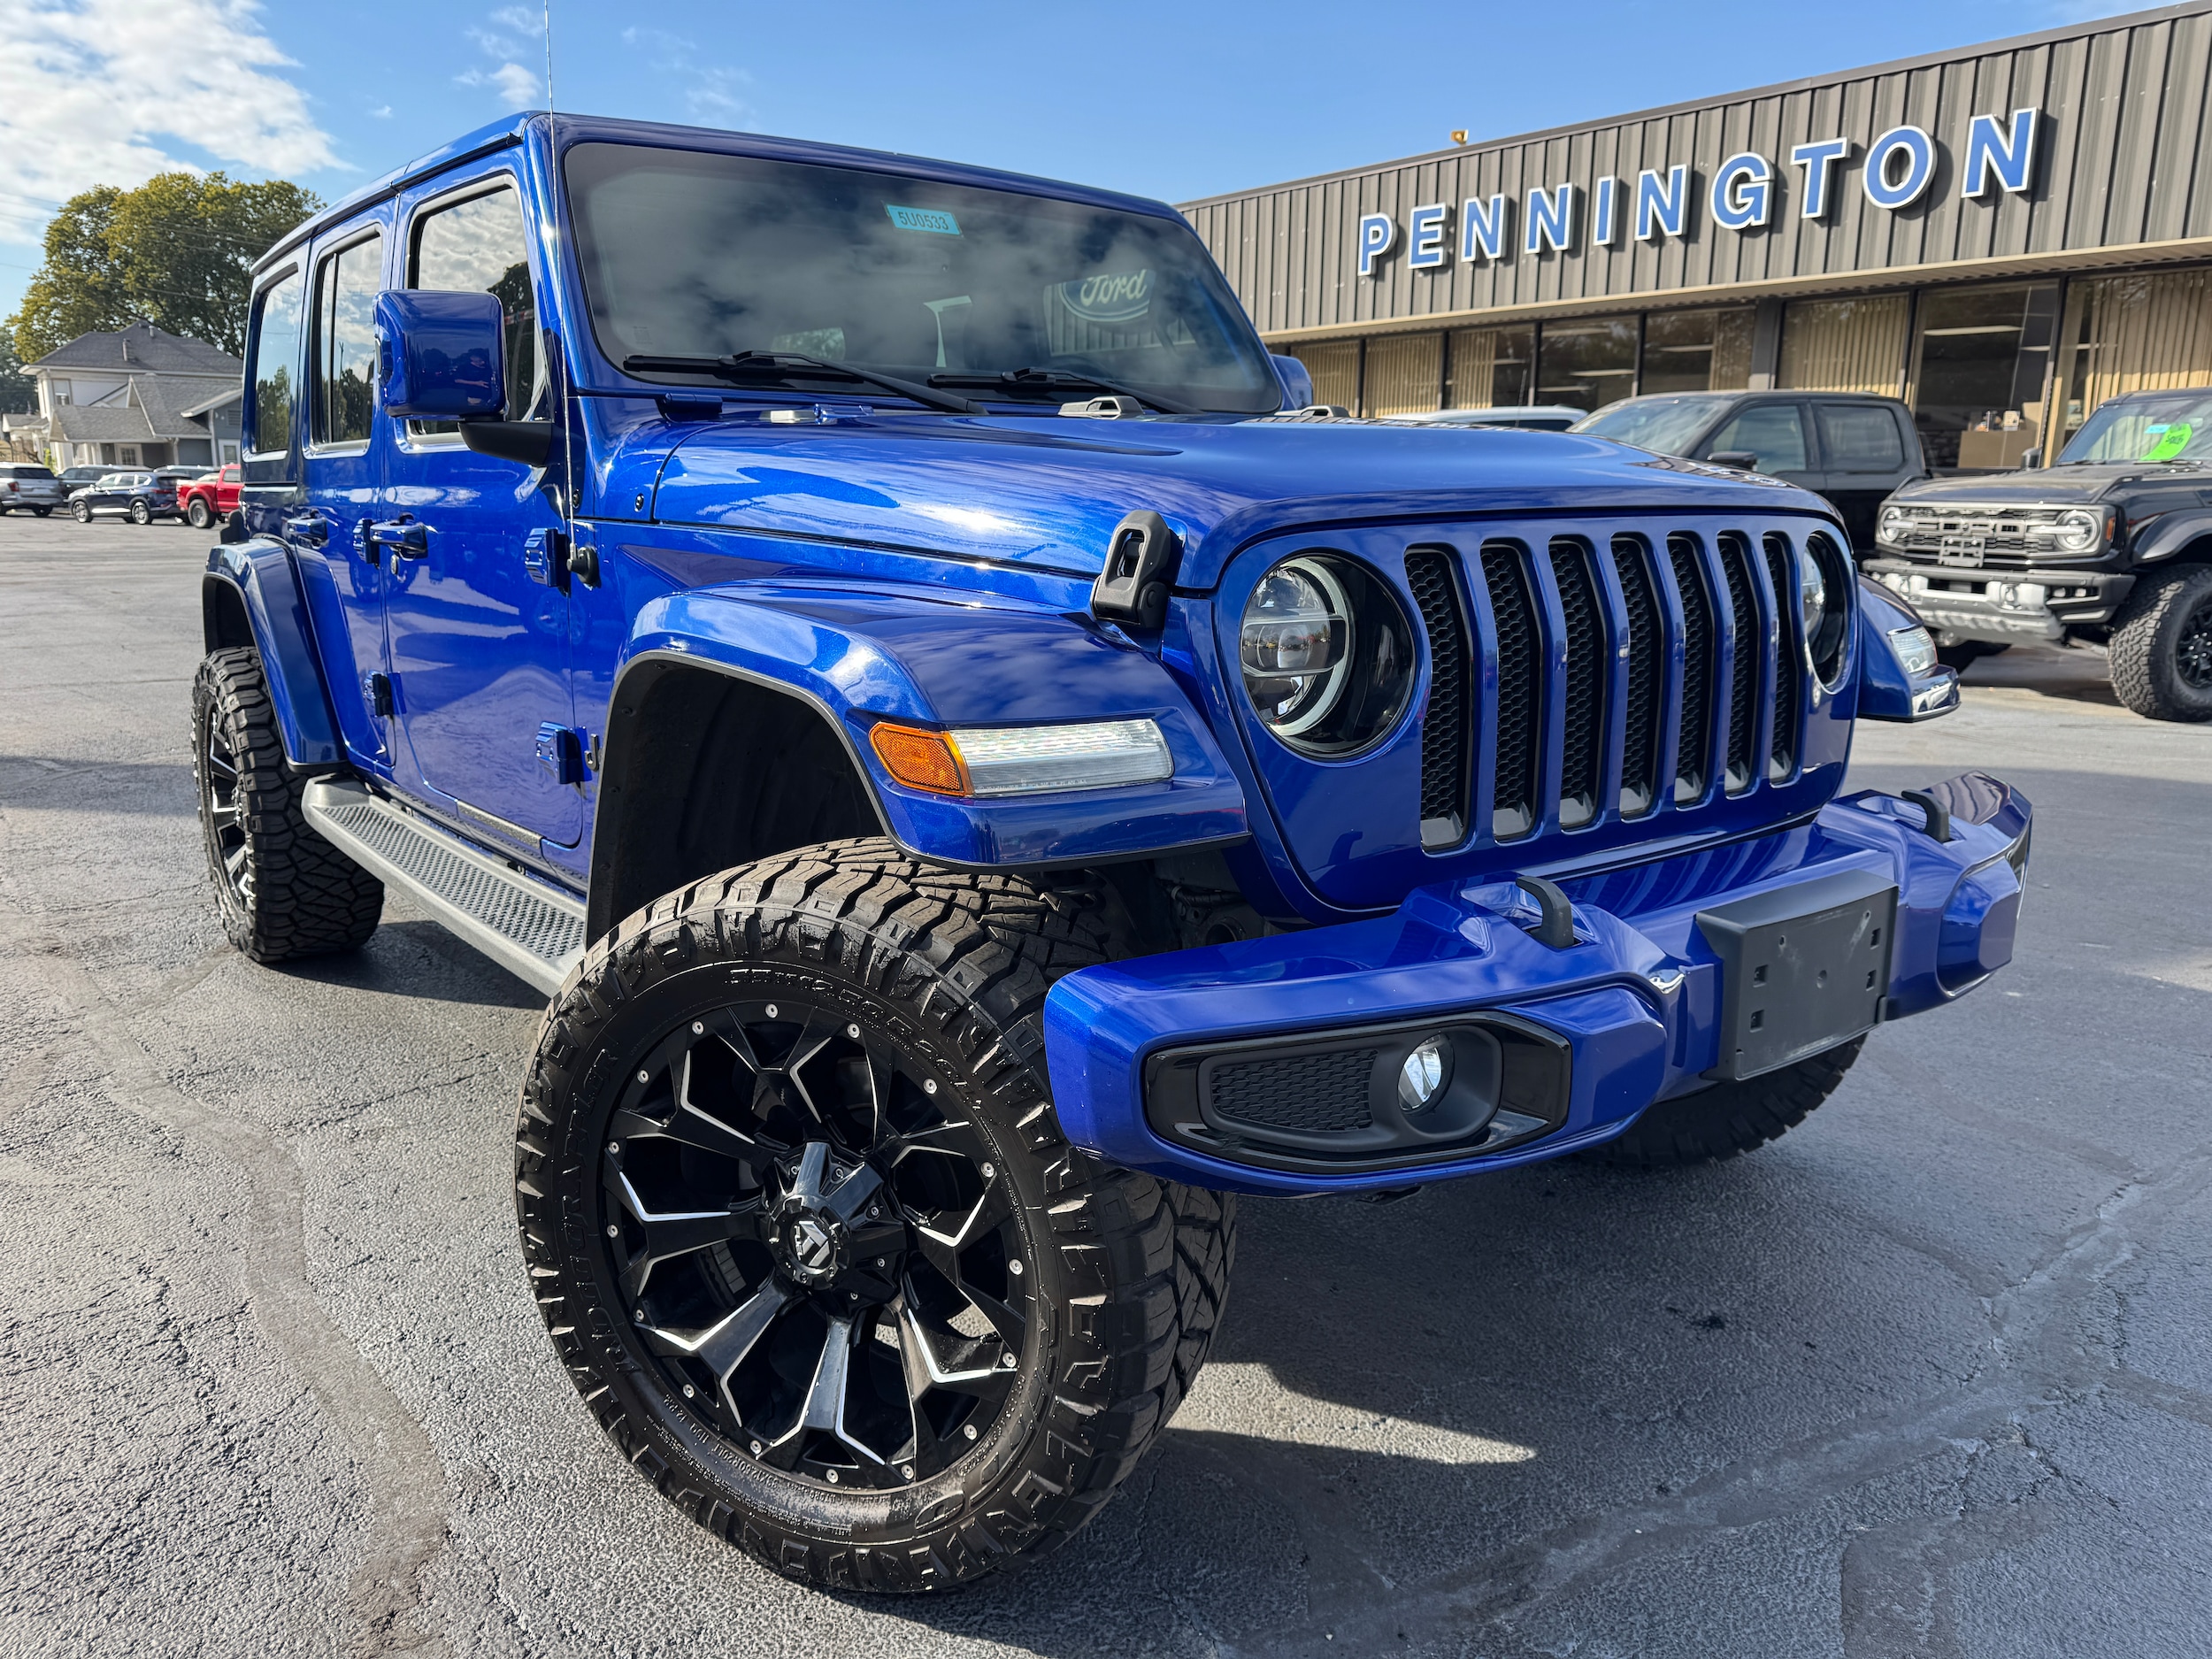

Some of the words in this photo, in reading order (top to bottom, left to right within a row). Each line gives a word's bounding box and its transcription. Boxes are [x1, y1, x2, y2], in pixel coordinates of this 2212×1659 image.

[1358, 107, 2040, 275] PENNINGTON
[897, 211, 949, 231] 5U0533
[1080, 269, 1148, 307] Ford
[1916, 518, 2024, 538] FORD
[794, 1224, 804, 1261] FUEL
